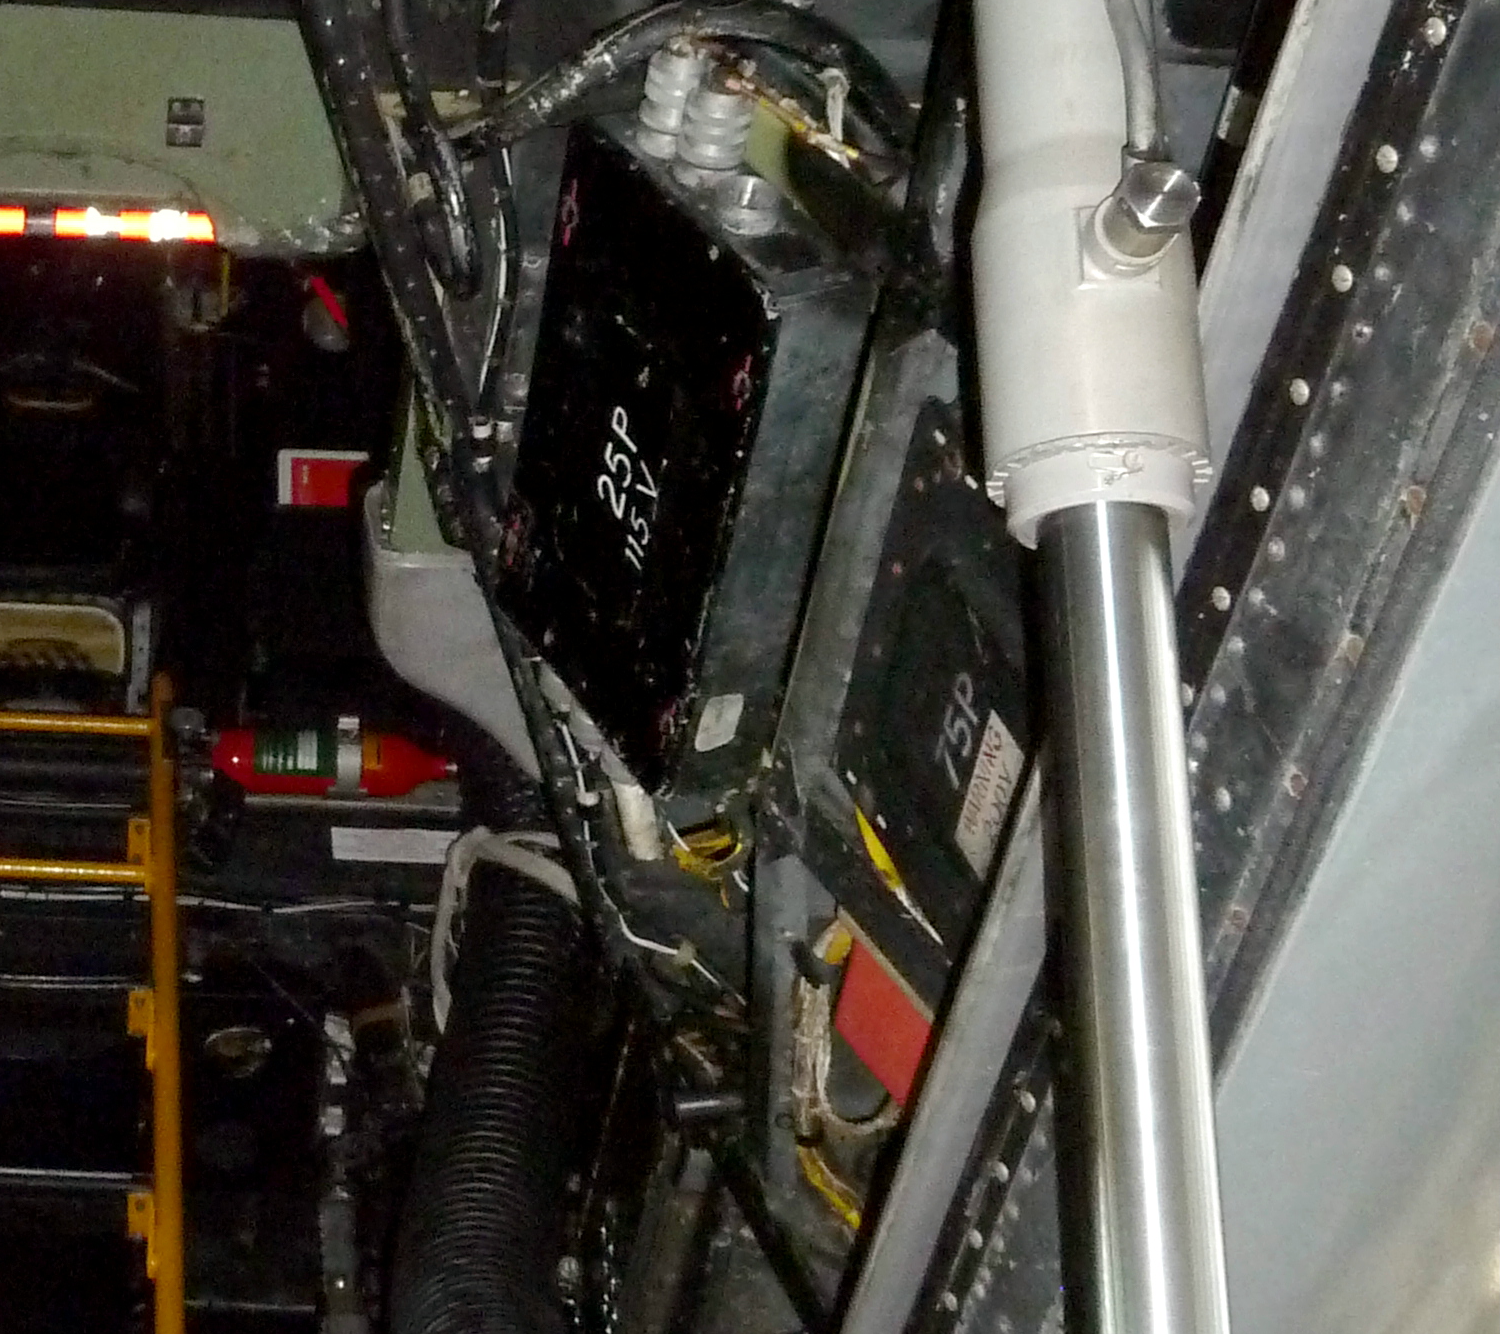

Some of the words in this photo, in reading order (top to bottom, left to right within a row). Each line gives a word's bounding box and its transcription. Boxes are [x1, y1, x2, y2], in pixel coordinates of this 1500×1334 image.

[597, 405, 638, 520] 25P
[625, 505, 650, 570] 115
[963, 724, 1004, 836] WARNING
